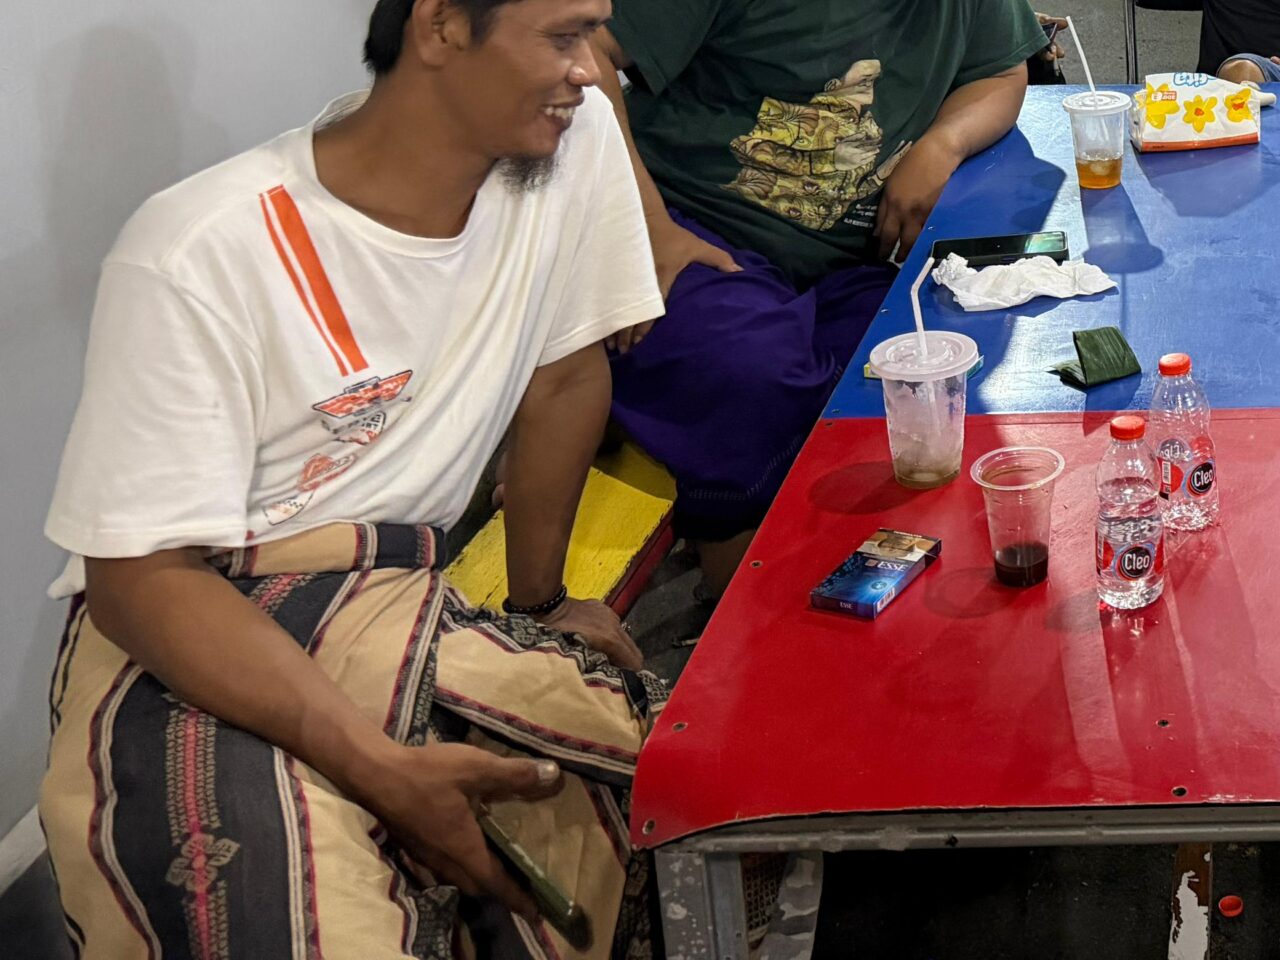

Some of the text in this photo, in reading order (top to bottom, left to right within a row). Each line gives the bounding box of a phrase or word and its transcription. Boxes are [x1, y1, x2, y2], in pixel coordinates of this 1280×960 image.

[1194, 469, 1213, 487] Cleo
[877, 561, 908, 572] ESSE
[1125, 553, 1150, 570] Cleo
[840, 602, 853, 610] ESSE
